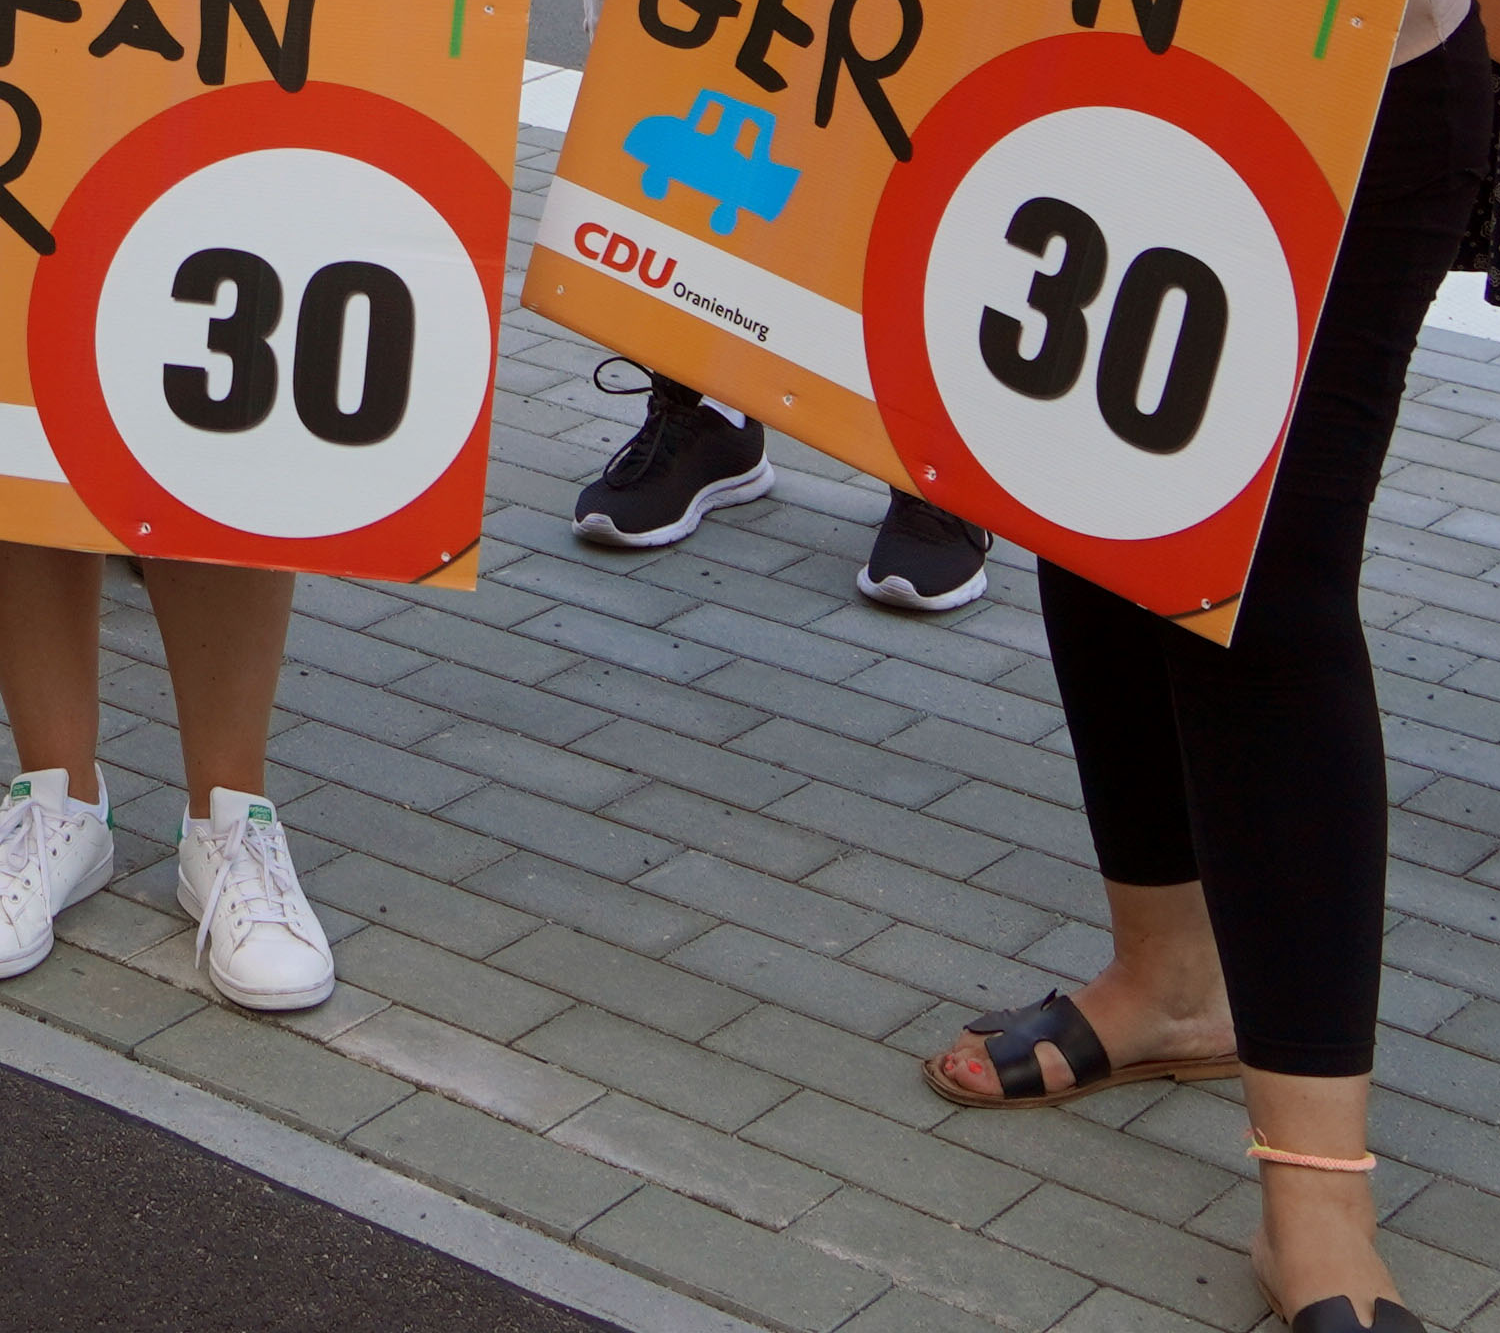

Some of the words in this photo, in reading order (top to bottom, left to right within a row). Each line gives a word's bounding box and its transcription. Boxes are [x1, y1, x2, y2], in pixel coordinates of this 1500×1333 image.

[162, 248, 416, 446] 30
[574, 222, 678, 288] CDU
[673, 282, 769, 341] Oranienburg
[978, 197, 1229, 456] 30
